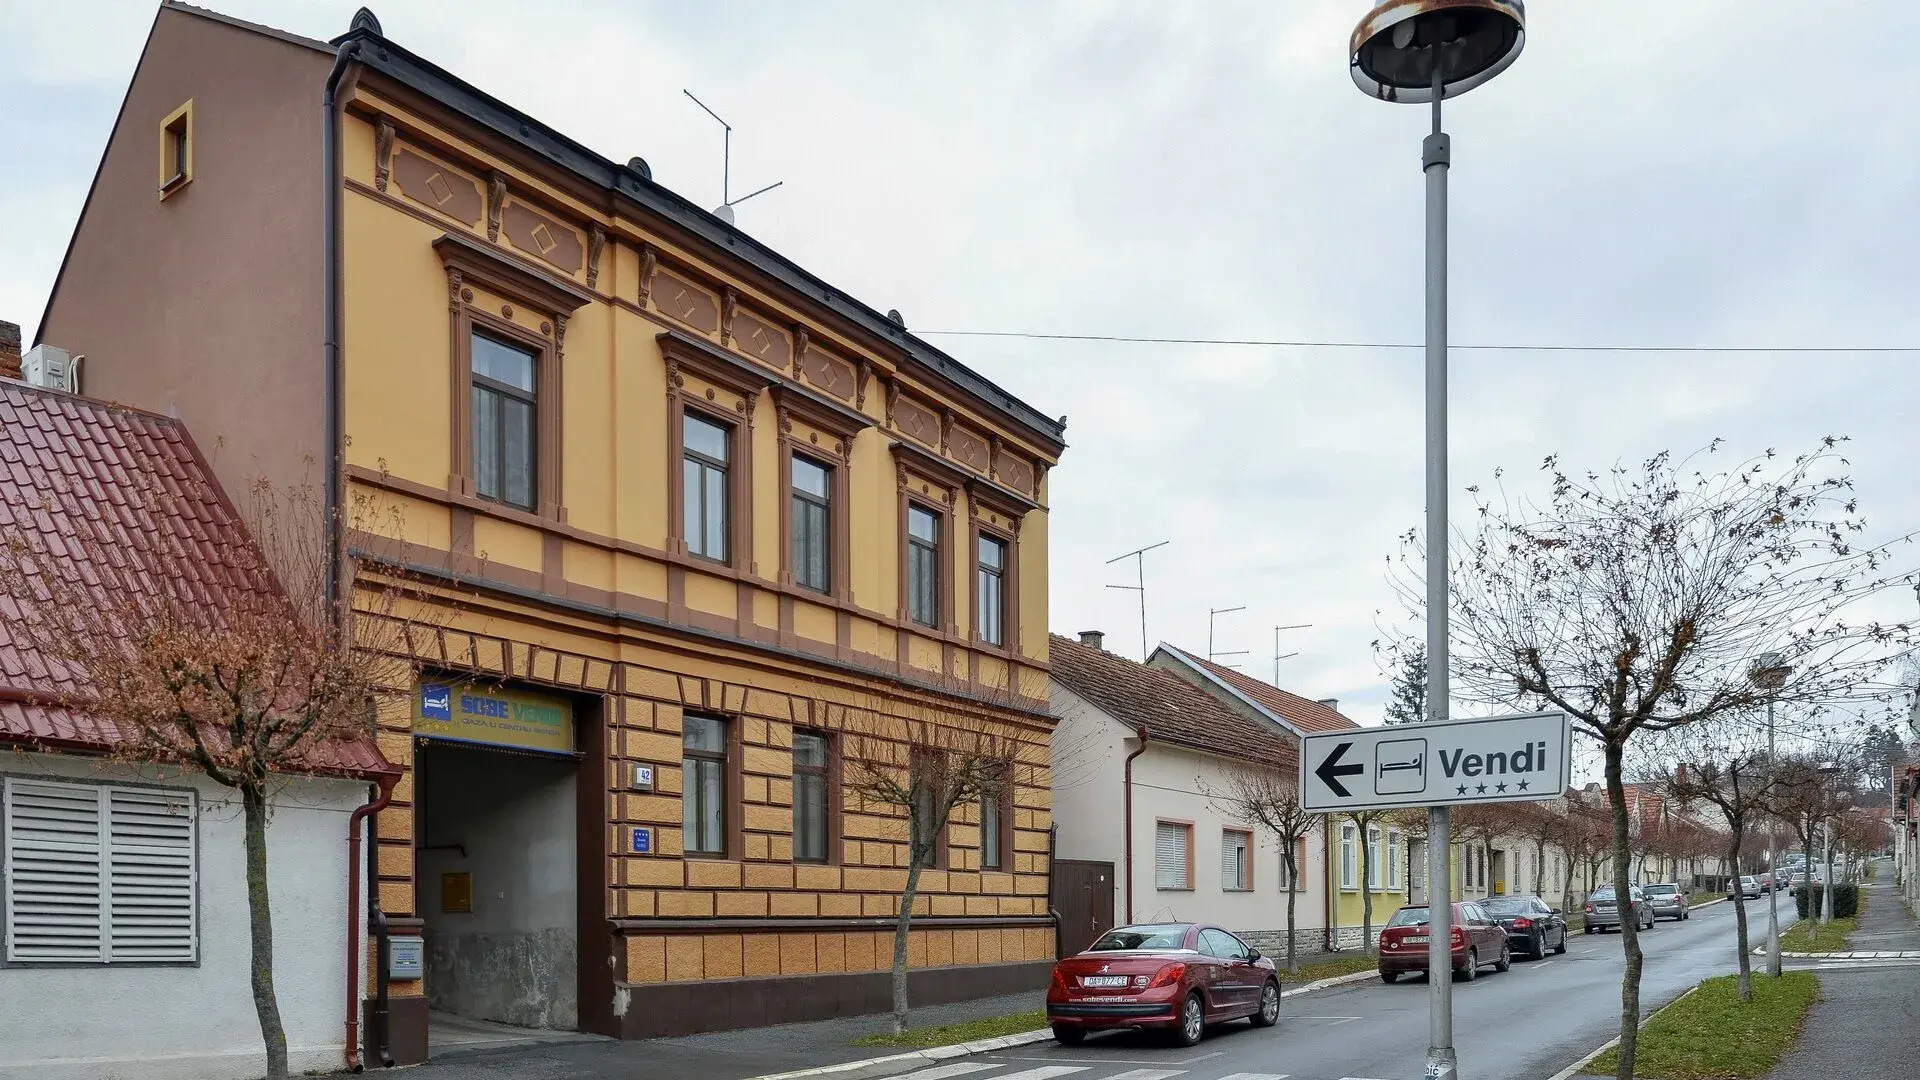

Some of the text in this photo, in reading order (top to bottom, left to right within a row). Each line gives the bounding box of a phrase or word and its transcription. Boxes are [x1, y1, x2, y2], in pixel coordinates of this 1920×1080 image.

[461, 695, 509, 719] SOBE
[1438, 741, 1546, 778] Vendi
[641, 770, 650, 780] 42
